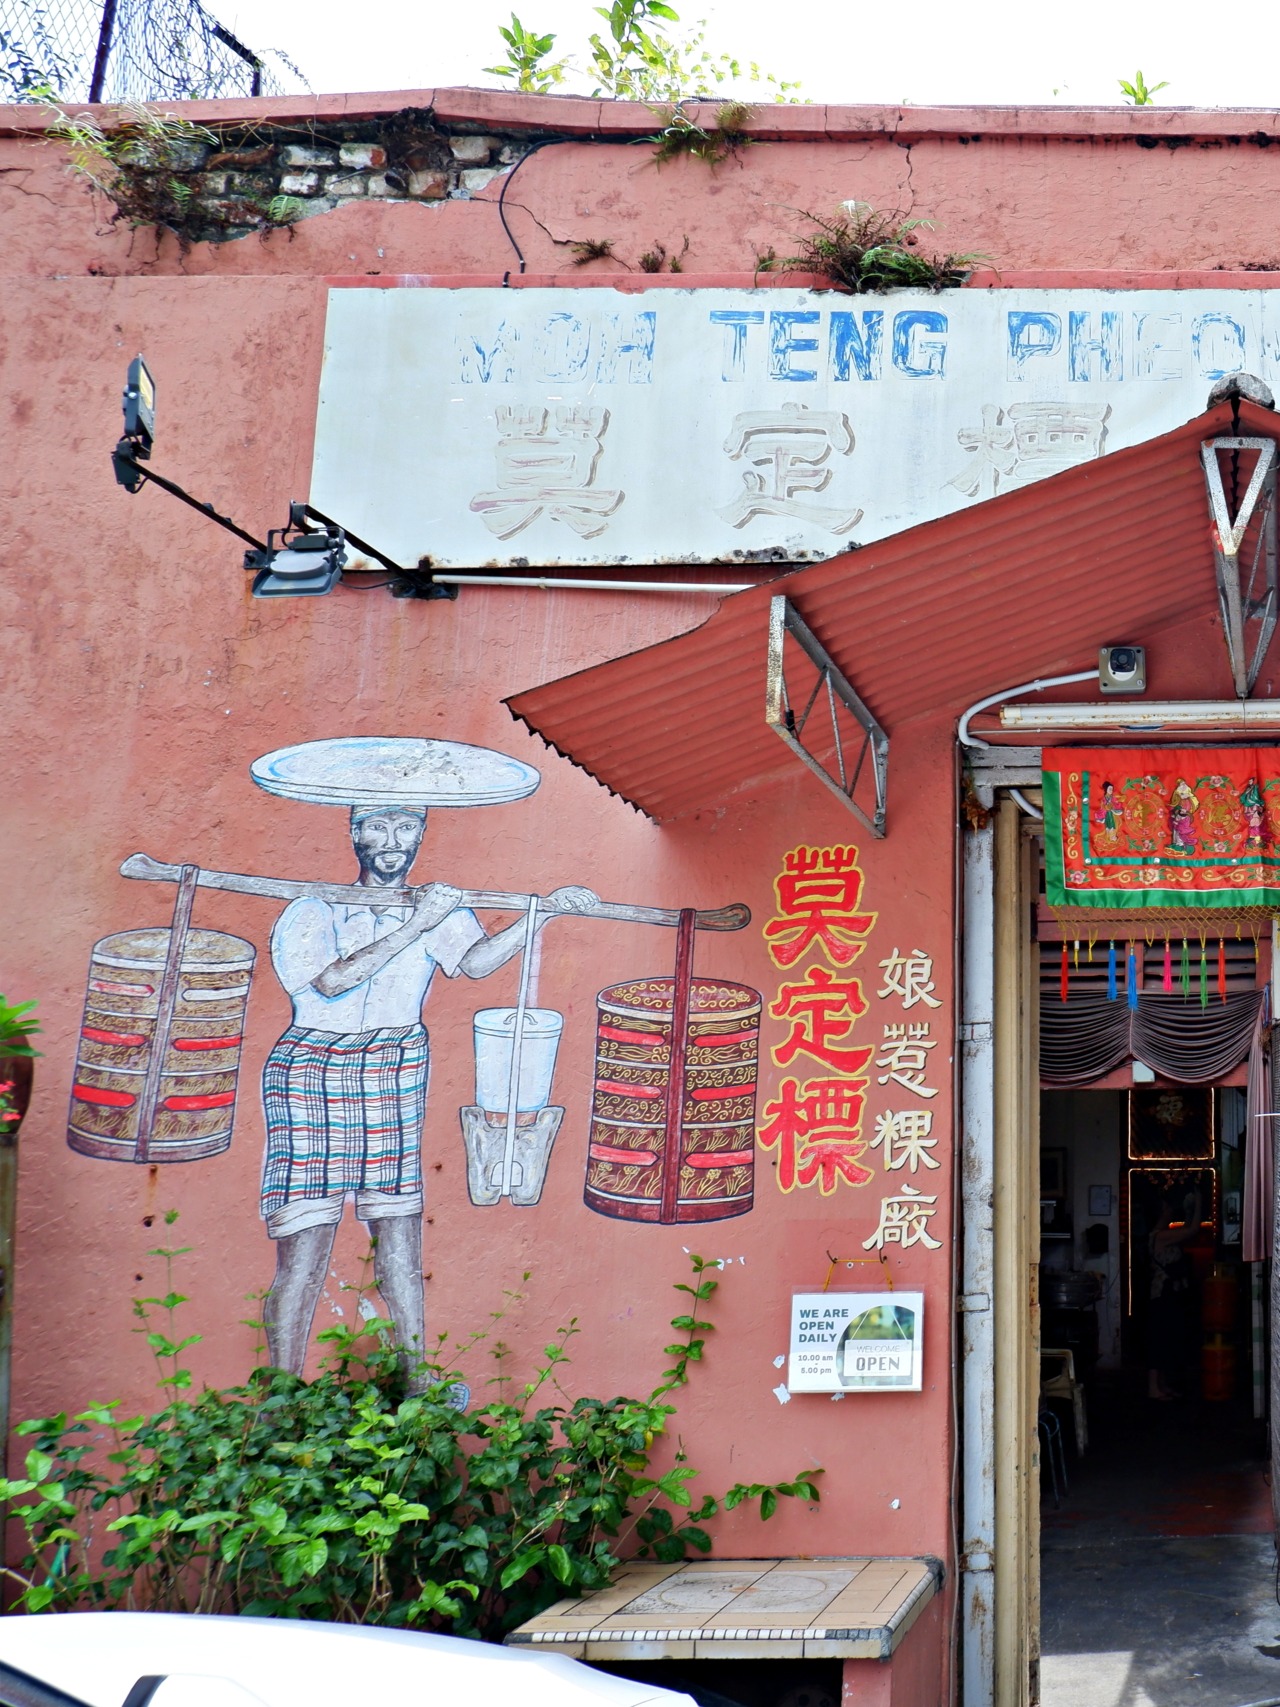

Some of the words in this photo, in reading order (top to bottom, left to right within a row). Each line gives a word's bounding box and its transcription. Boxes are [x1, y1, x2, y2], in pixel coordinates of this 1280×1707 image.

[451, 311, 658, 384] MOH
[709, 310, 950, 382] TENG
[862, 947, 943, 1251] 娘惹粿廠
[799, 1309, 819, 1318] WE
[823, 1308, 849, 1318] ARE
[799, 1321, 834, 1331] OPEN
[799, 1333, 837, 1343] DAILY
[856, 1345, 900, 1353] WELCOME
[798, 1354, 820, 1362] 10.00
[856, 1356, 900, 1371] OPEN
[820, 1367, 832, 1375] pm
